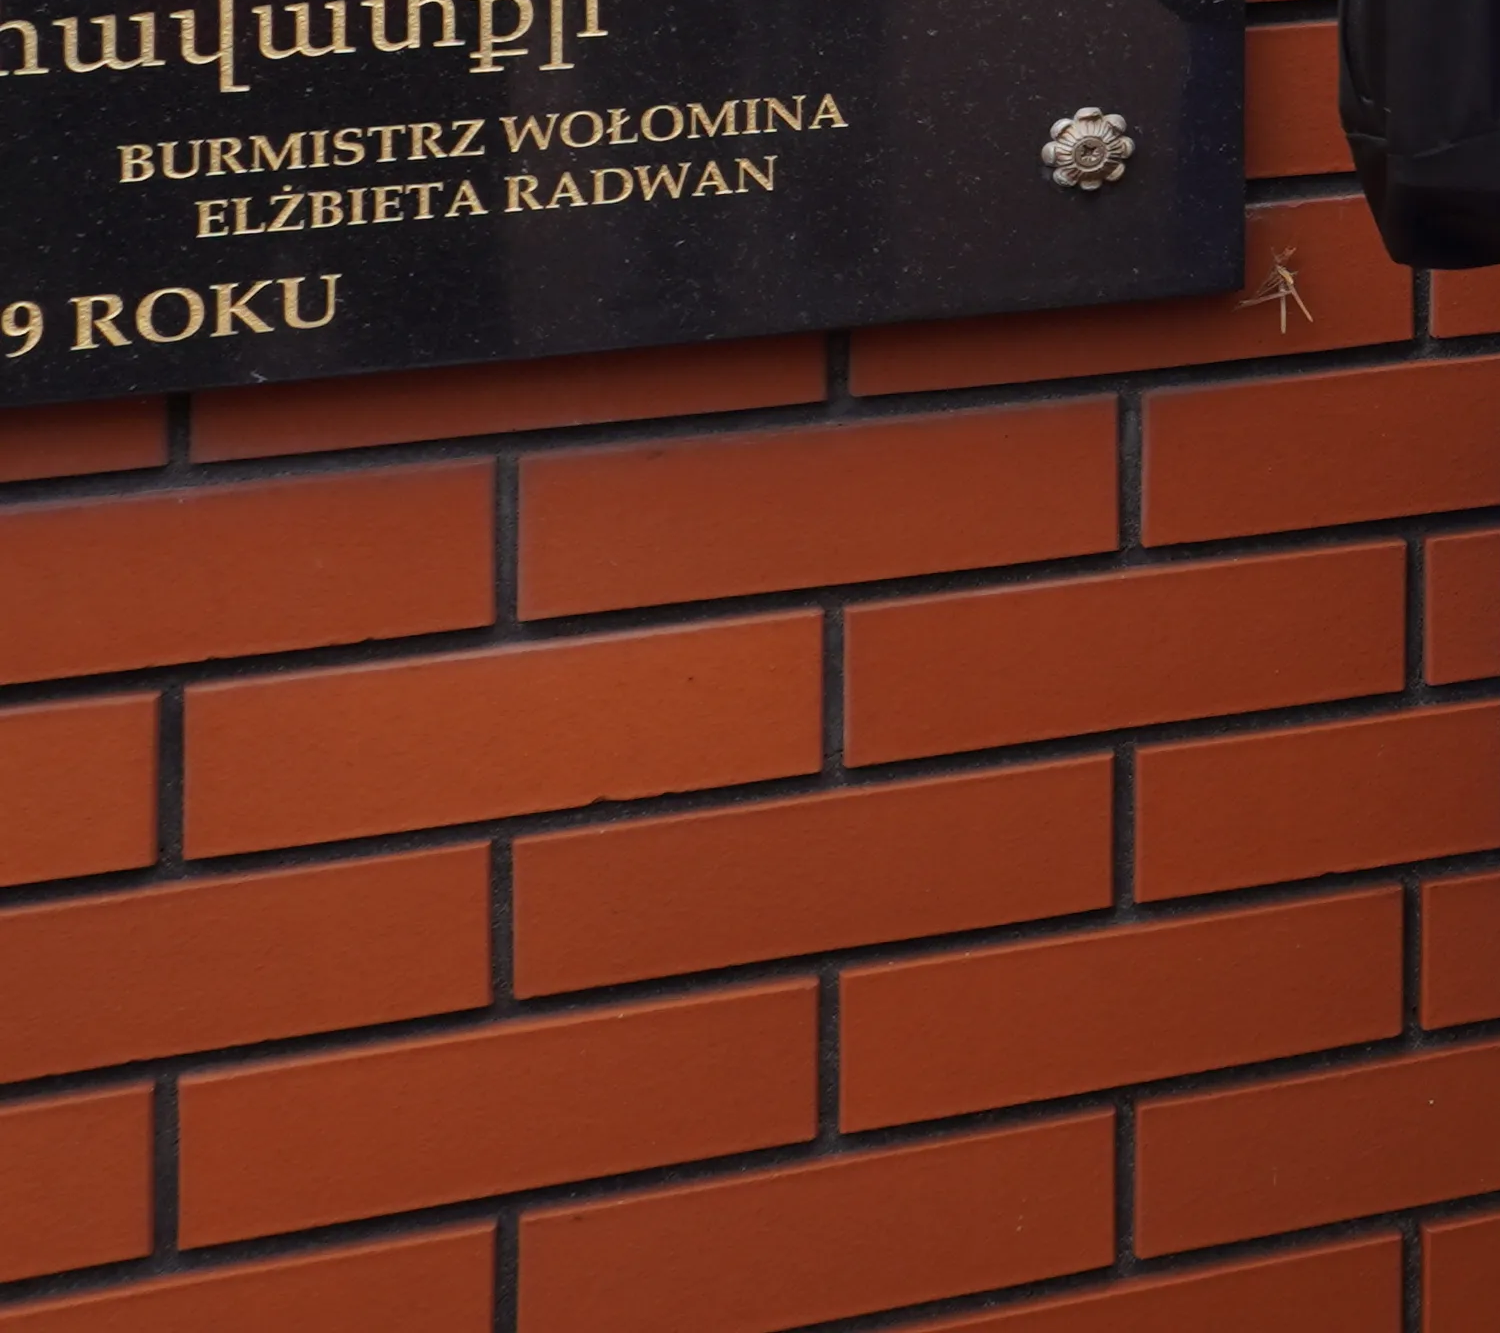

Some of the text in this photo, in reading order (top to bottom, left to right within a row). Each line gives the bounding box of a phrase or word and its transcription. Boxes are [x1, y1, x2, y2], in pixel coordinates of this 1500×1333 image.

[117, 93, 850, 183] BURMISTRZ WOŁOMINA
[195, 155, 778, 238] ELŻBIETA RADWAN
[69, 274, 342, 352] ROKU
